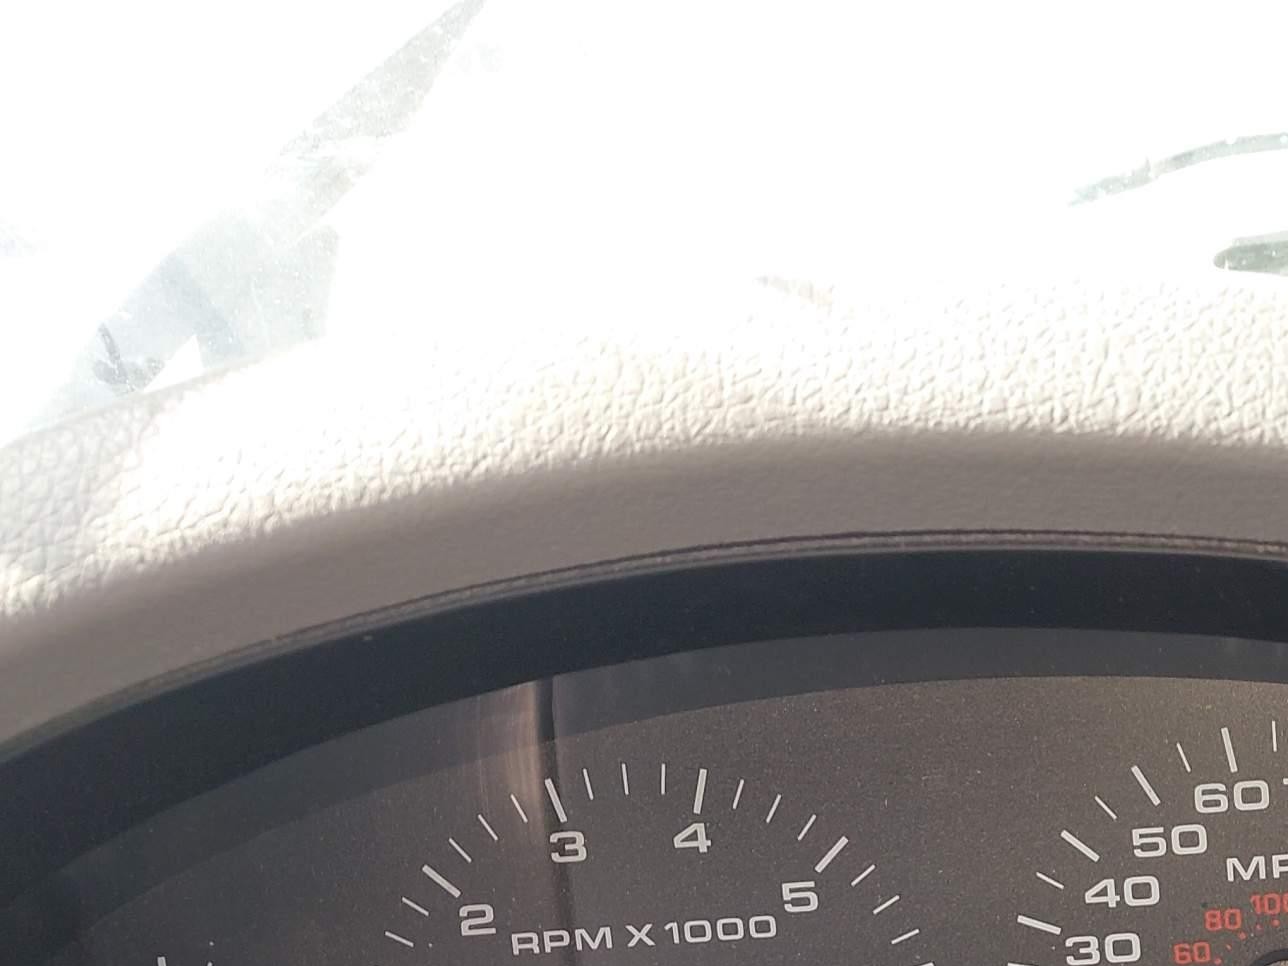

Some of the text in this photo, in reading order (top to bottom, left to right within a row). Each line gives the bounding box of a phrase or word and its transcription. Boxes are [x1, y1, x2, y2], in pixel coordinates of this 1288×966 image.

[1194, 780, 1269, 813] 60
[550, 831, 587, 862] 3
[673, 823, 711, 853] 4
[1132, 824, 1208, 857] 50
[781, 881, 818, 912] 5
[1085, 876, 1160, 908] 40
[460, 904, 497, 936] 2
[511, 915, 777, 955] RPM X 1000
[1204, 909, 1242, 931] 80
[1065, 933, 1141, 966] 30
[1173, 942, 1211, 964] 60
